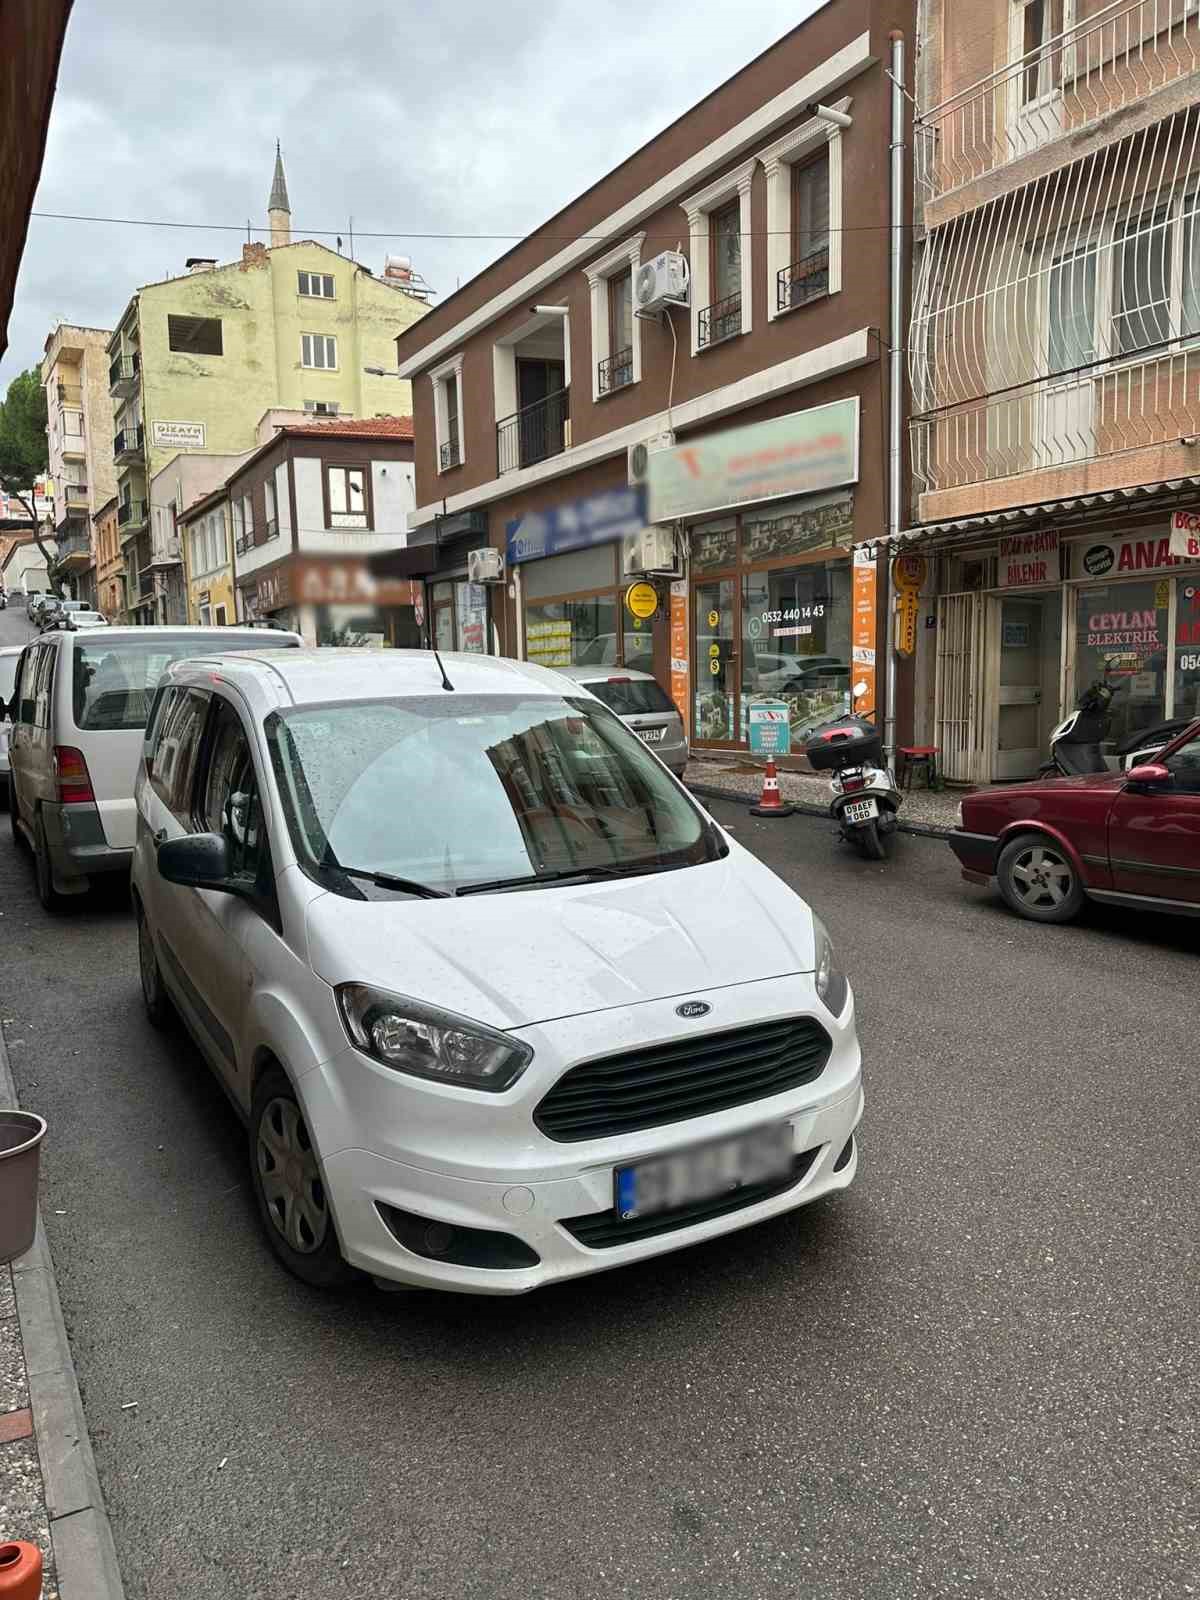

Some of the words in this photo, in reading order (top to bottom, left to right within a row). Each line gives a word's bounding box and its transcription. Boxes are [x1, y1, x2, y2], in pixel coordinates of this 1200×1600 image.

[762, 610, 782, 623] 0532
[783, 608, 800, 620] 440
[801, 606, 811, 618] 14
[812, 604, 825, 617] 43
[1089, 609, 1157, 631] CEYLAN
[1087, 627, 1159, 646] ELEKTRİK
[682, 1002, 706, 1016] Ford
